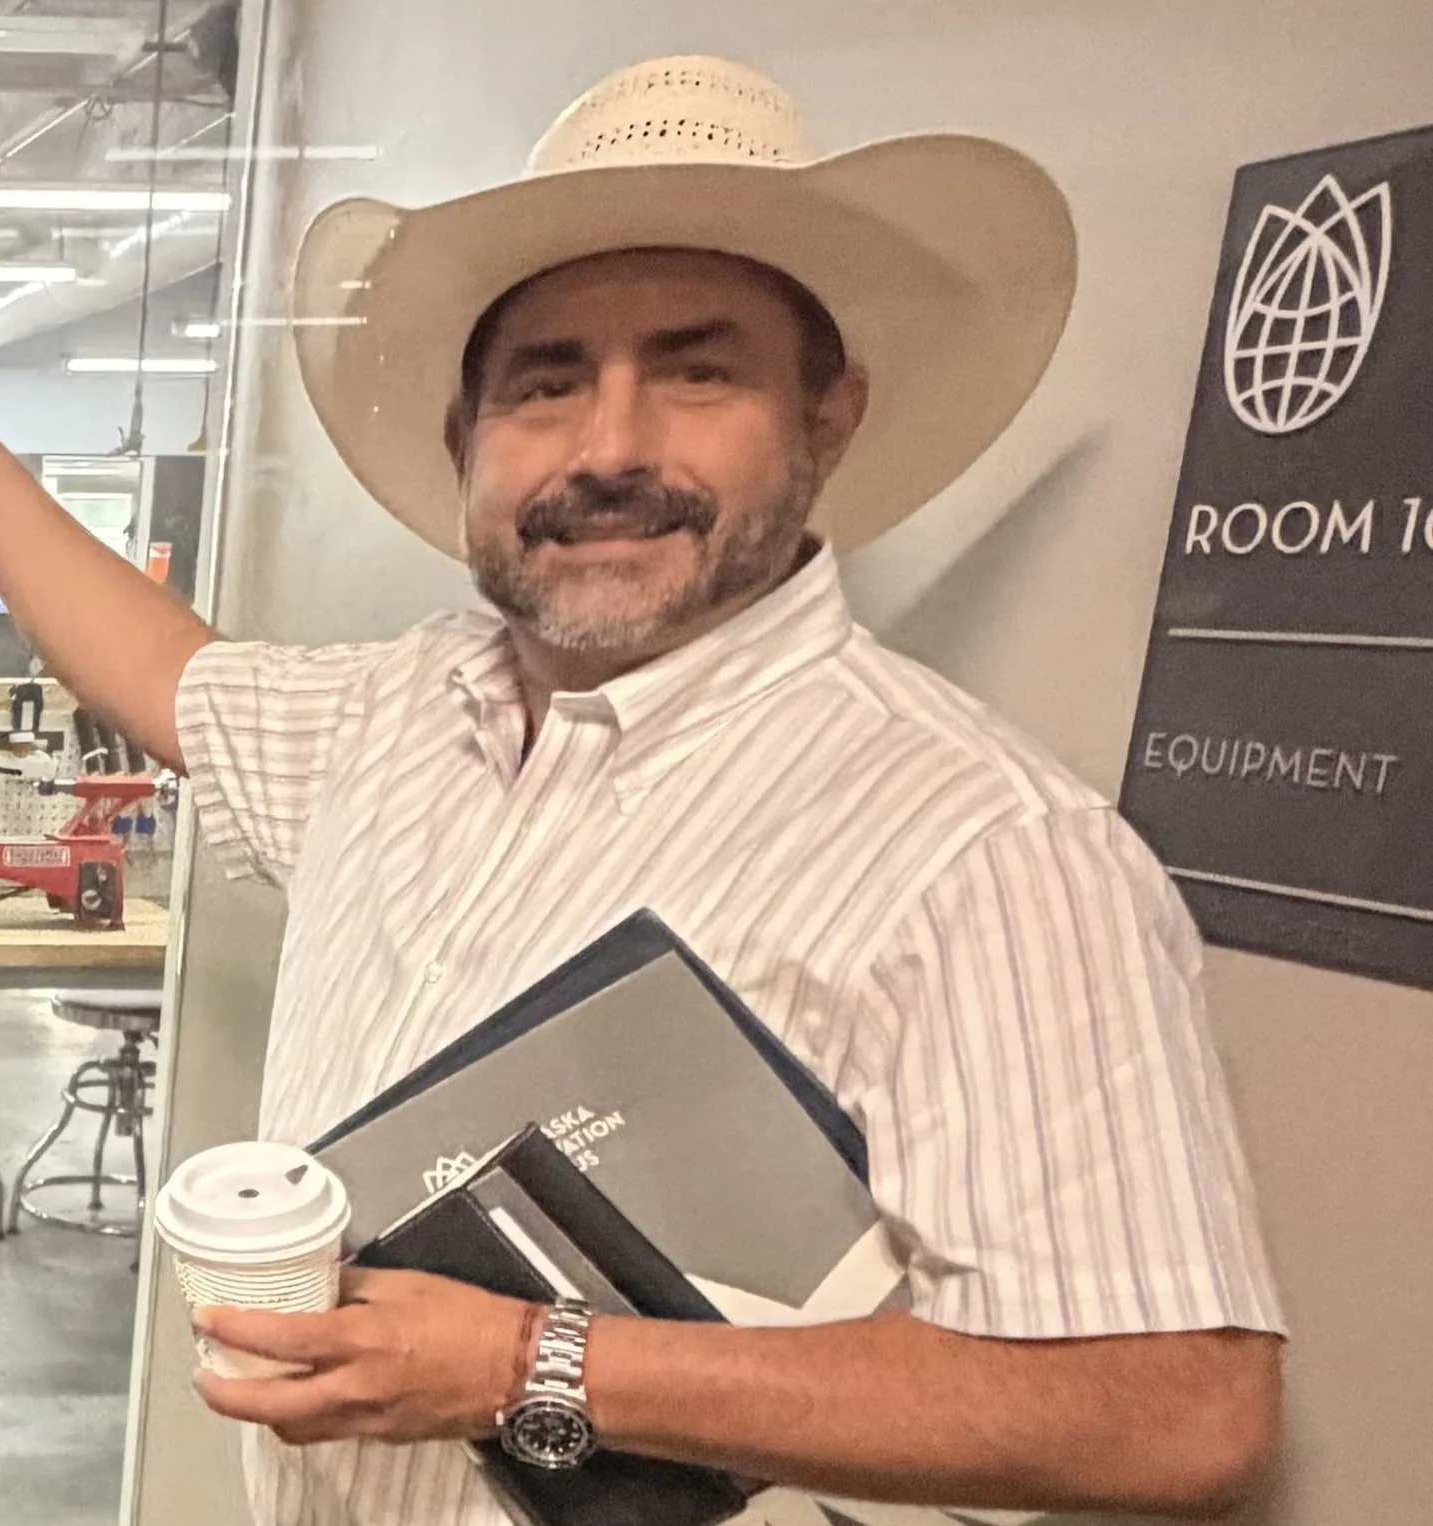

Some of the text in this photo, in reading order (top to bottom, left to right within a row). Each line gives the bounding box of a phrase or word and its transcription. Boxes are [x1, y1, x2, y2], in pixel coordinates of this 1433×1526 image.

[1184, 497, 1433, 555] ROOM 1
[1143, 731, 1399, 794] EQUIPMENT
